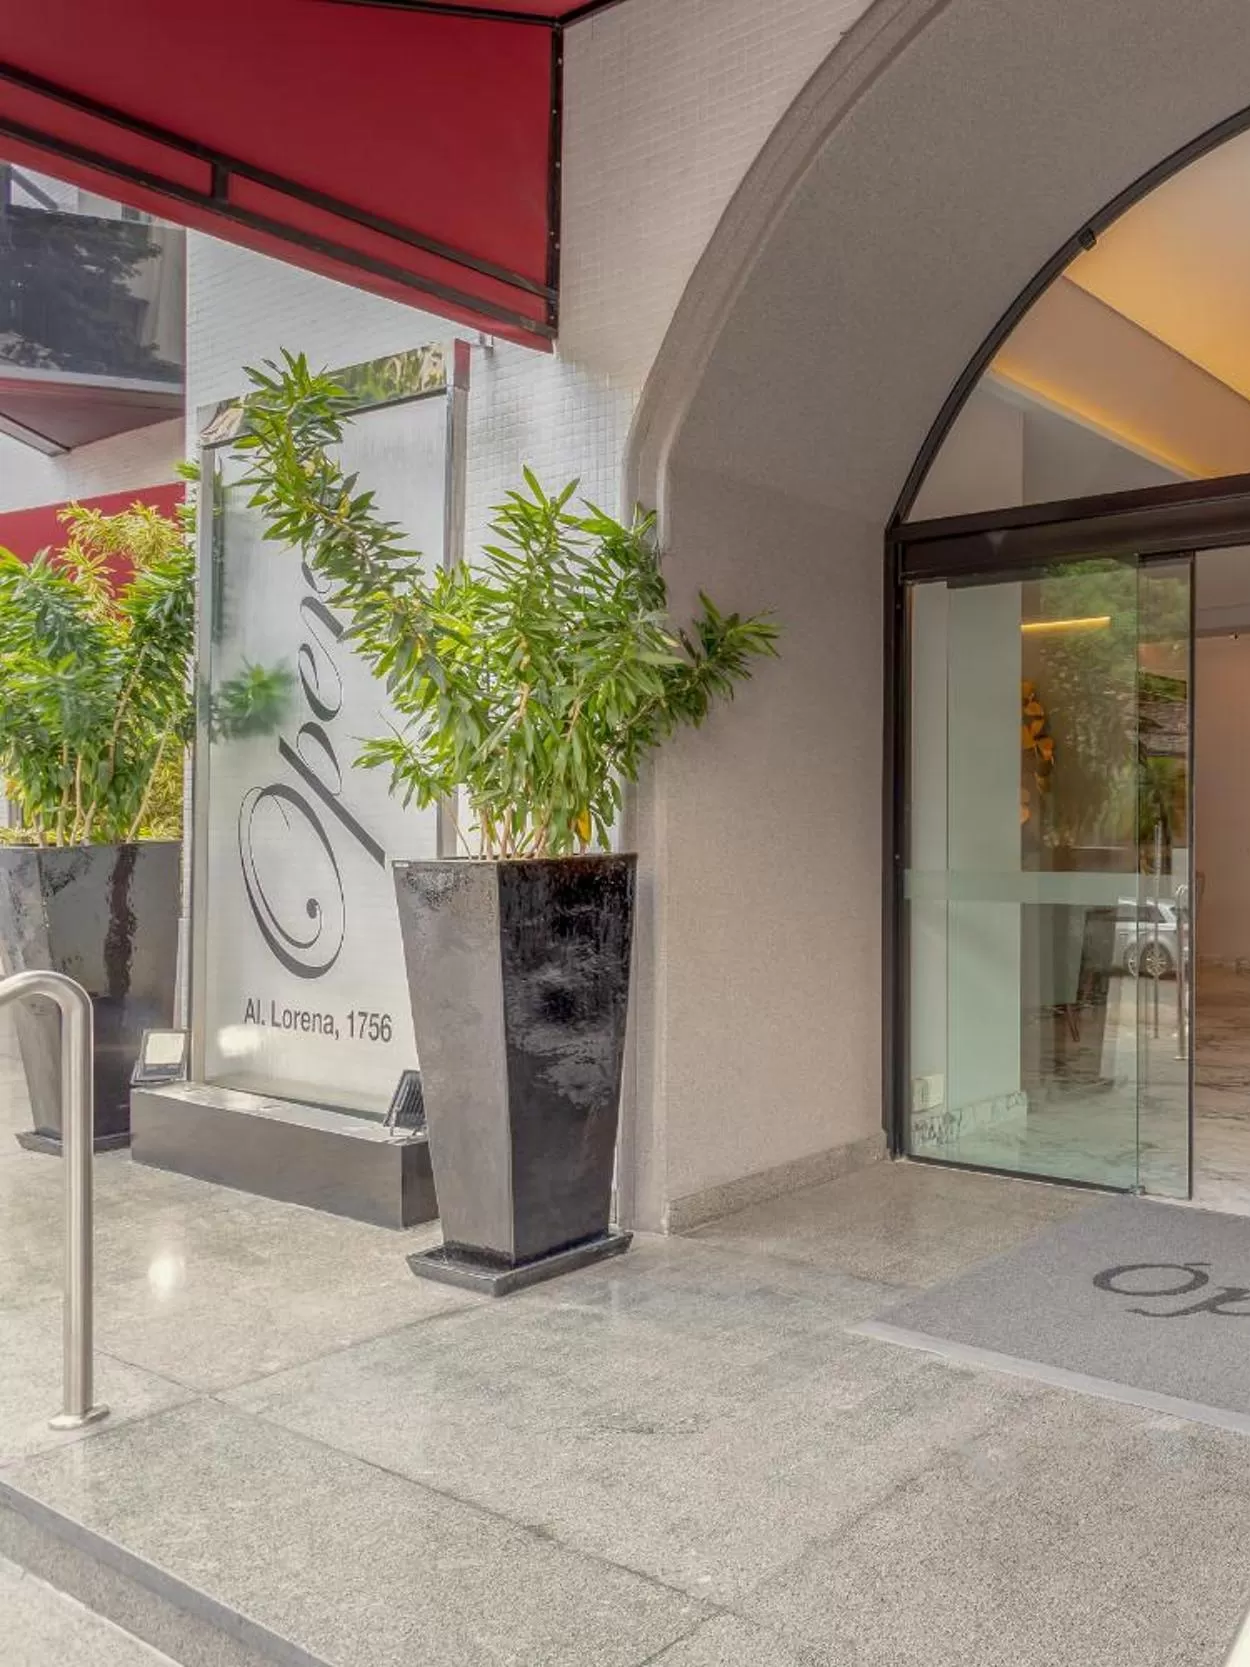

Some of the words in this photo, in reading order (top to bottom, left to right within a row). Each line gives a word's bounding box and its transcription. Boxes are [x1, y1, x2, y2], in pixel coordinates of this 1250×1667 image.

[243, 998, 266, 1026] Al.
[271, 1000, 340, 1040] Lorena,
[347, 1010, 393, 1042] 1756
